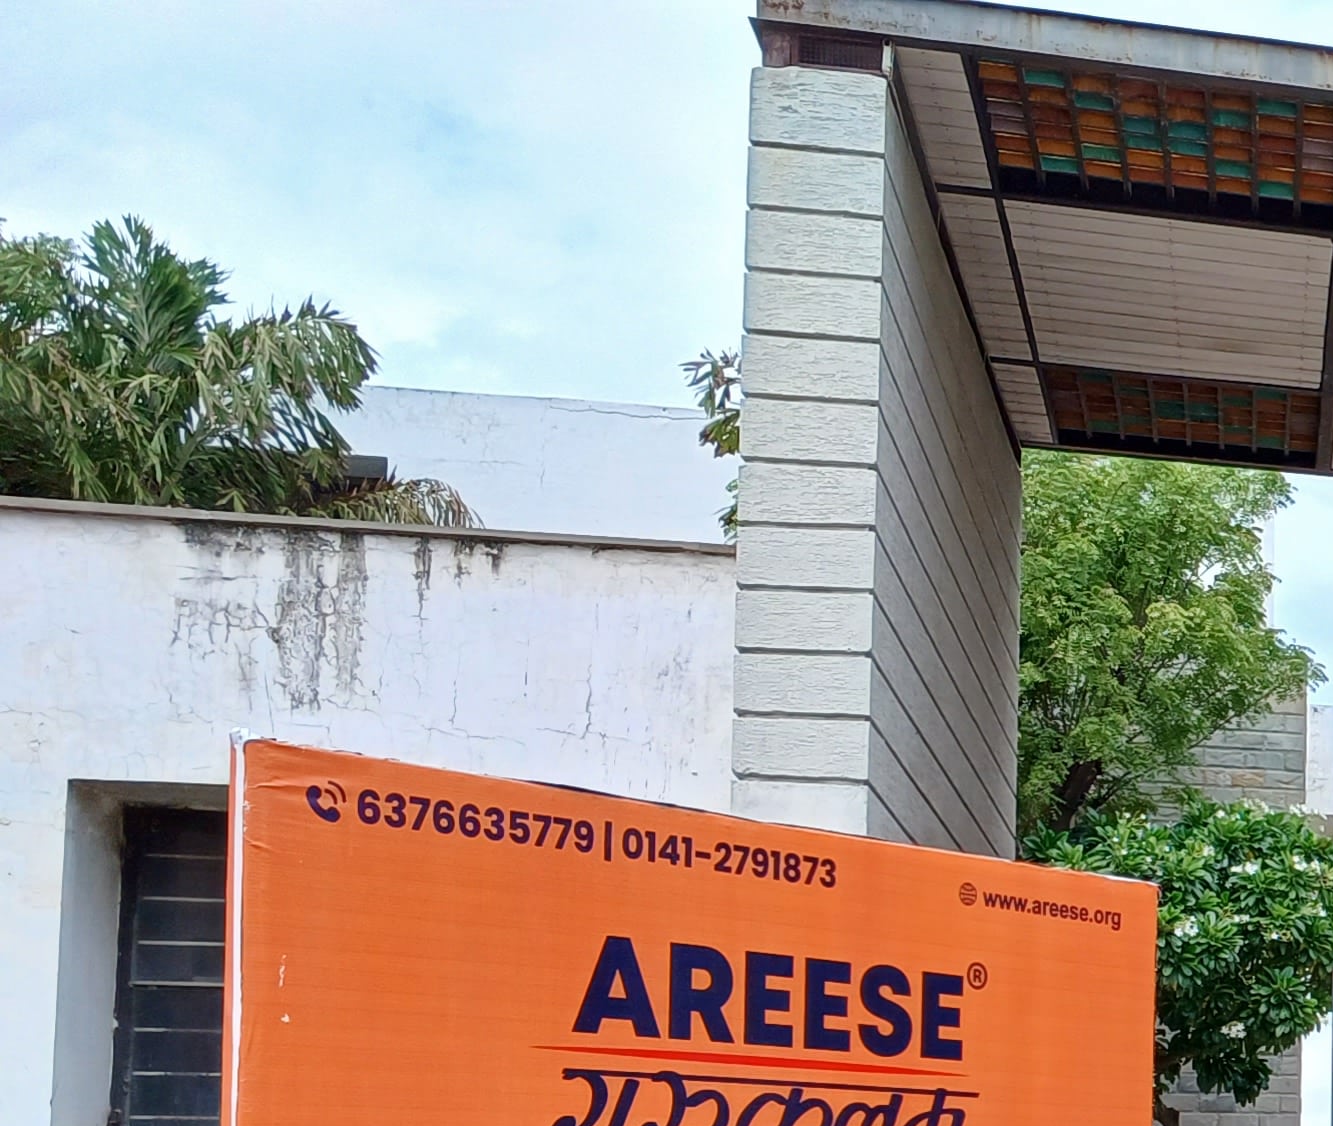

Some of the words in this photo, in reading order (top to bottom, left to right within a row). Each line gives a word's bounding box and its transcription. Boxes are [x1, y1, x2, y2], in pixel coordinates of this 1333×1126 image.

[358, 790, 594, 852] 6376635779
[623, 828, 838, 887] 0141-2791873
[984, 893, 1120, 930] www.areese.org
